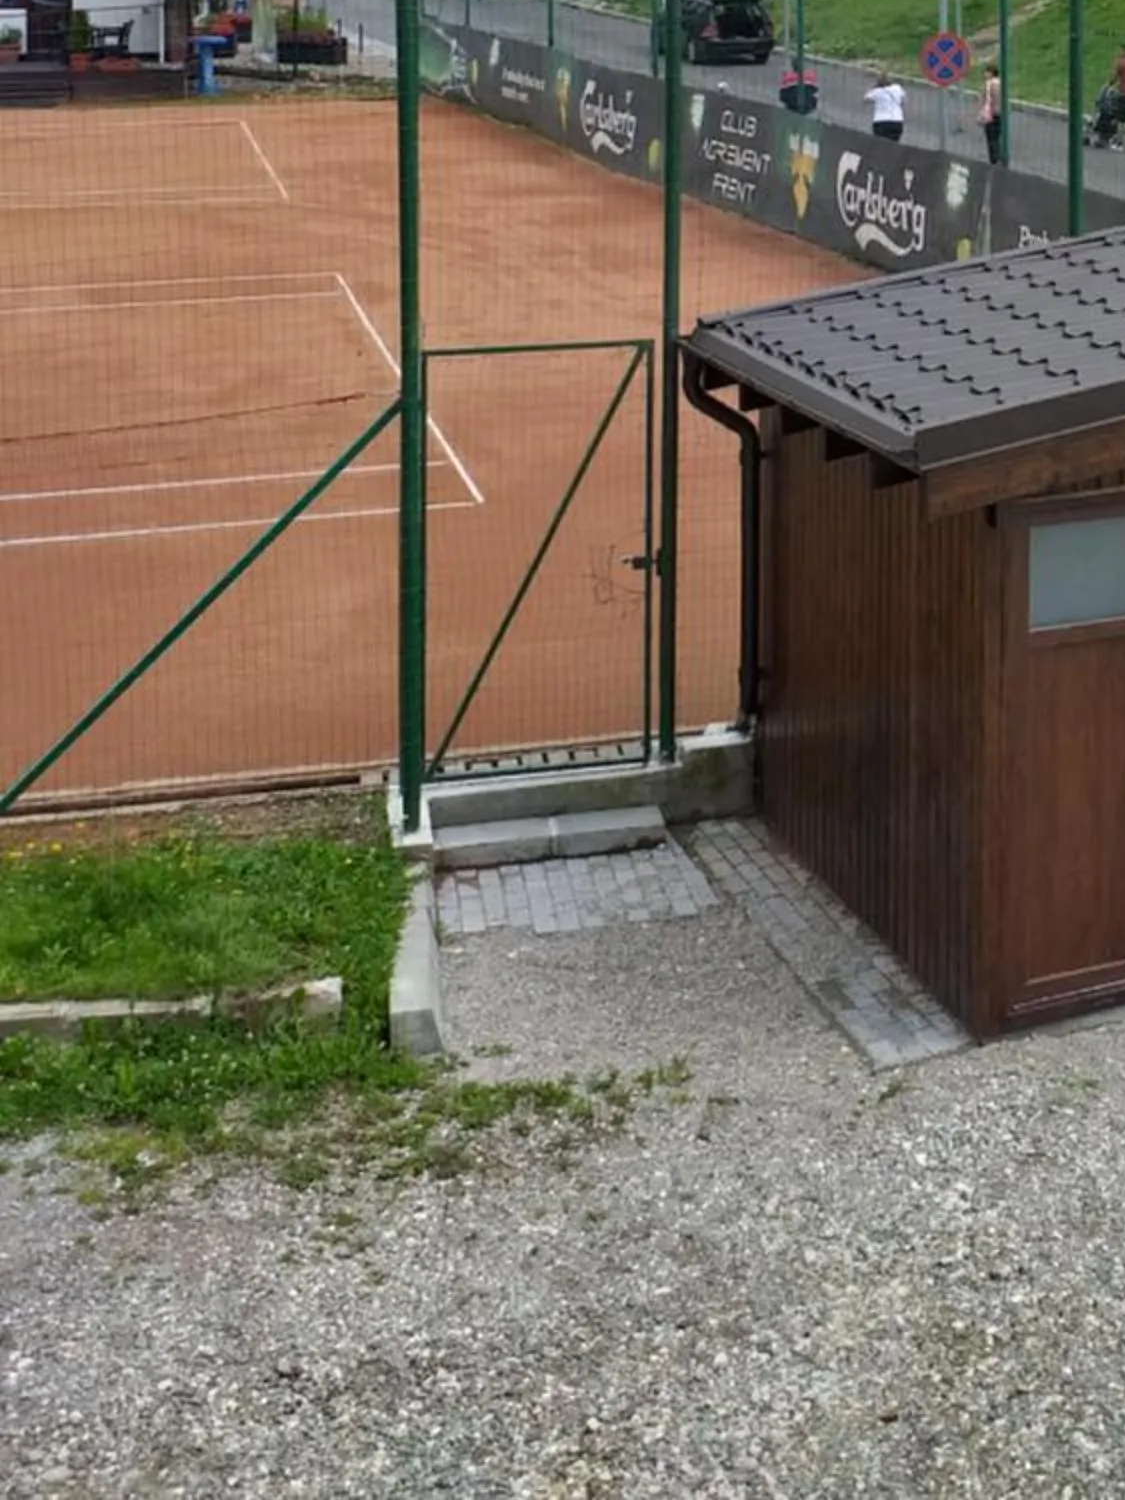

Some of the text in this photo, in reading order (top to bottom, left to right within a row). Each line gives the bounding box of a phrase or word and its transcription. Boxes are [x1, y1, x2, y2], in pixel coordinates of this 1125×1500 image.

[580, 80, 637, 155] Carlsberg
[720, 109, 757, 138] CLUB
[711, 172, 756, 204] FRENT
[837, 151, 926, 256] Carlsberg
